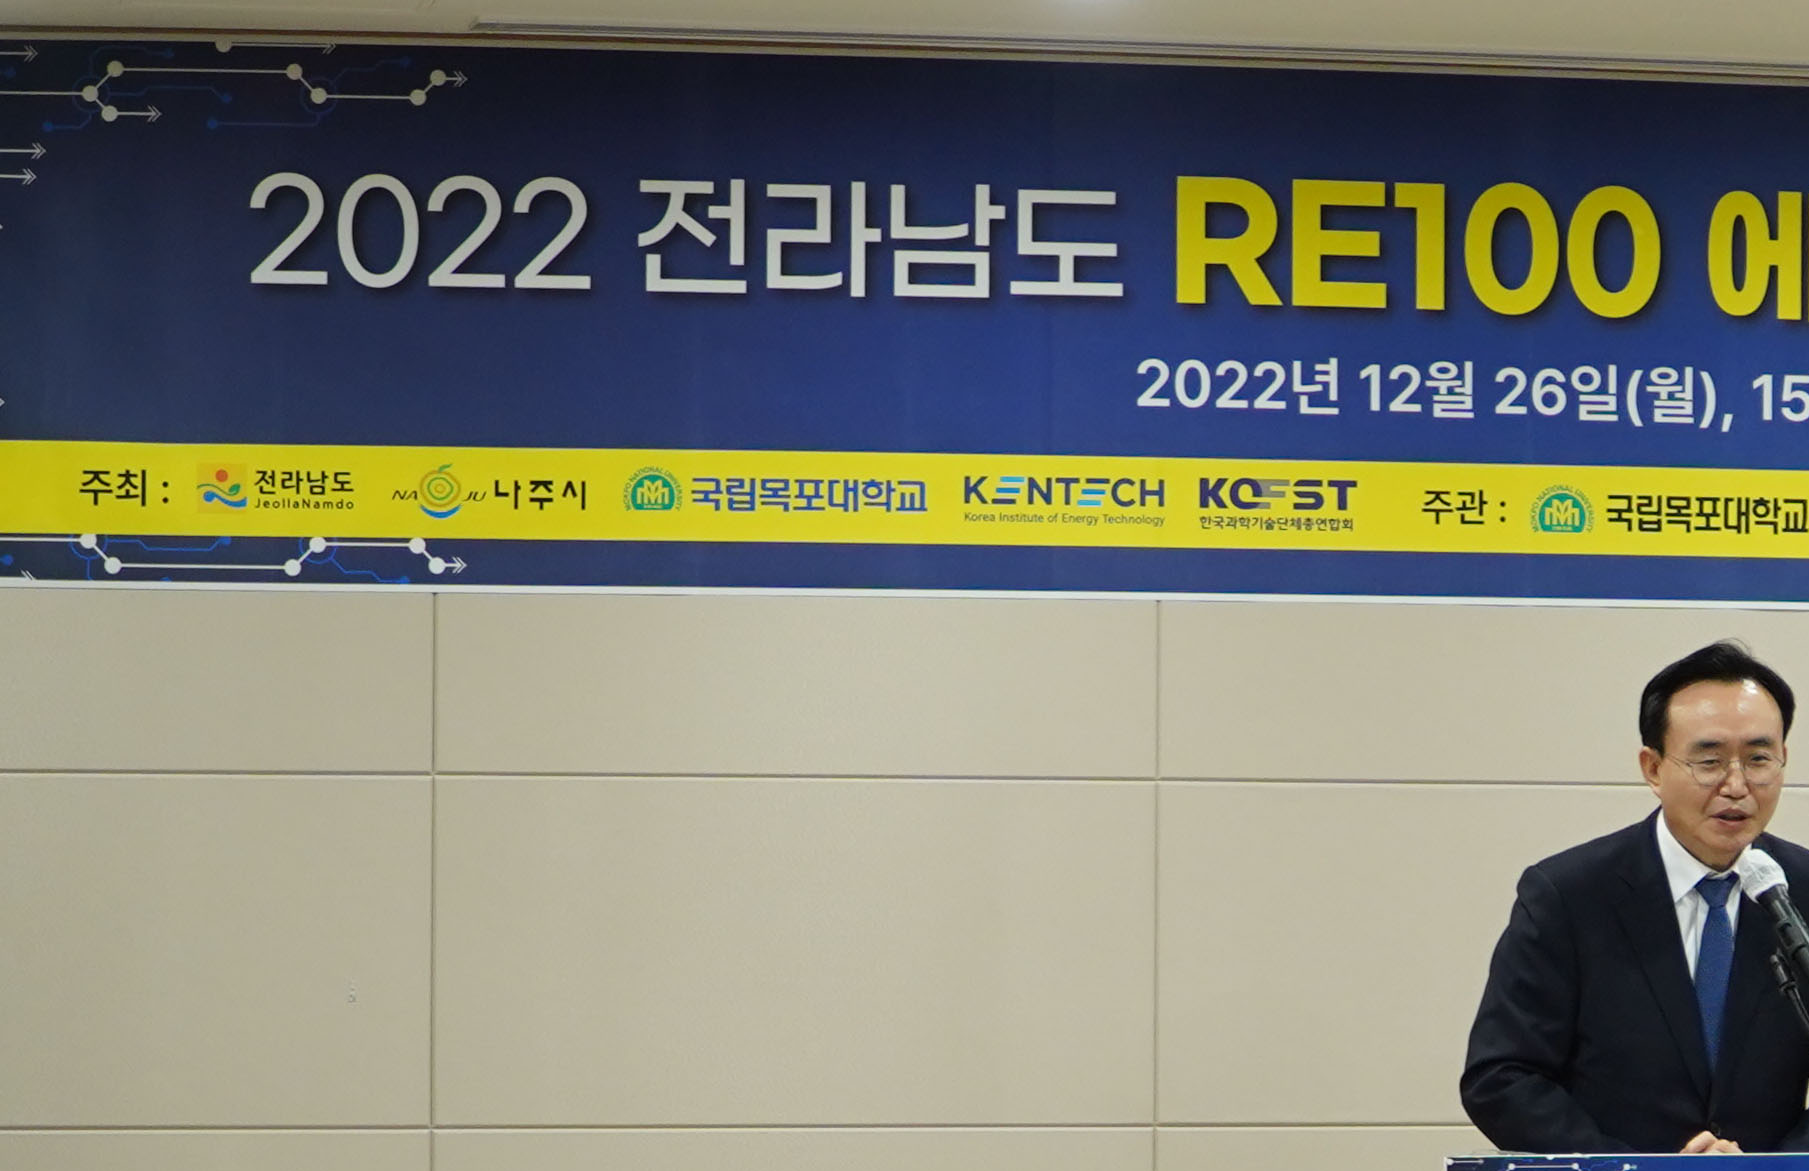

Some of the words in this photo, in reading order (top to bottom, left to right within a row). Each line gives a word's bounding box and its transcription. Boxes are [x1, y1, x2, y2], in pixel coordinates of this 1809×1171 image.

[249, 172, 591, 289] 2022
[637, 178, 1124, 299] 전라남도
[1176, 175, 1662, 319] RE100
[1135, 356, 1340, 416] 2022년
[1359, 359, 1475, 420] 12월
[1494, 363, 1733, 433] 26일(월),
[79, 468, 147, 507] 주최
[254, 469, 355, 495] 전라남도
[494, 479, 586, 511] 나주시
[691, 475, 929, 514] 국립목포대학교
[963, 475, 1166, 508] KENTECH
[254, 497, 355, 510] JeollaNamdo
[964, 511, 995, 522] Korea
[999, 512, 1044, 523] Institute
[1047, 513, 1058, 523] of
[1062, 514, 1099, 526] Energy
[1102, 514, 1166, 528] Technology
[1421, 488, 1488, 526] 주관
[1606, 494, 1809, 535] 국립목포대학교
[1199, 515, 1354, 532] 한국과학기술단체총연합회
